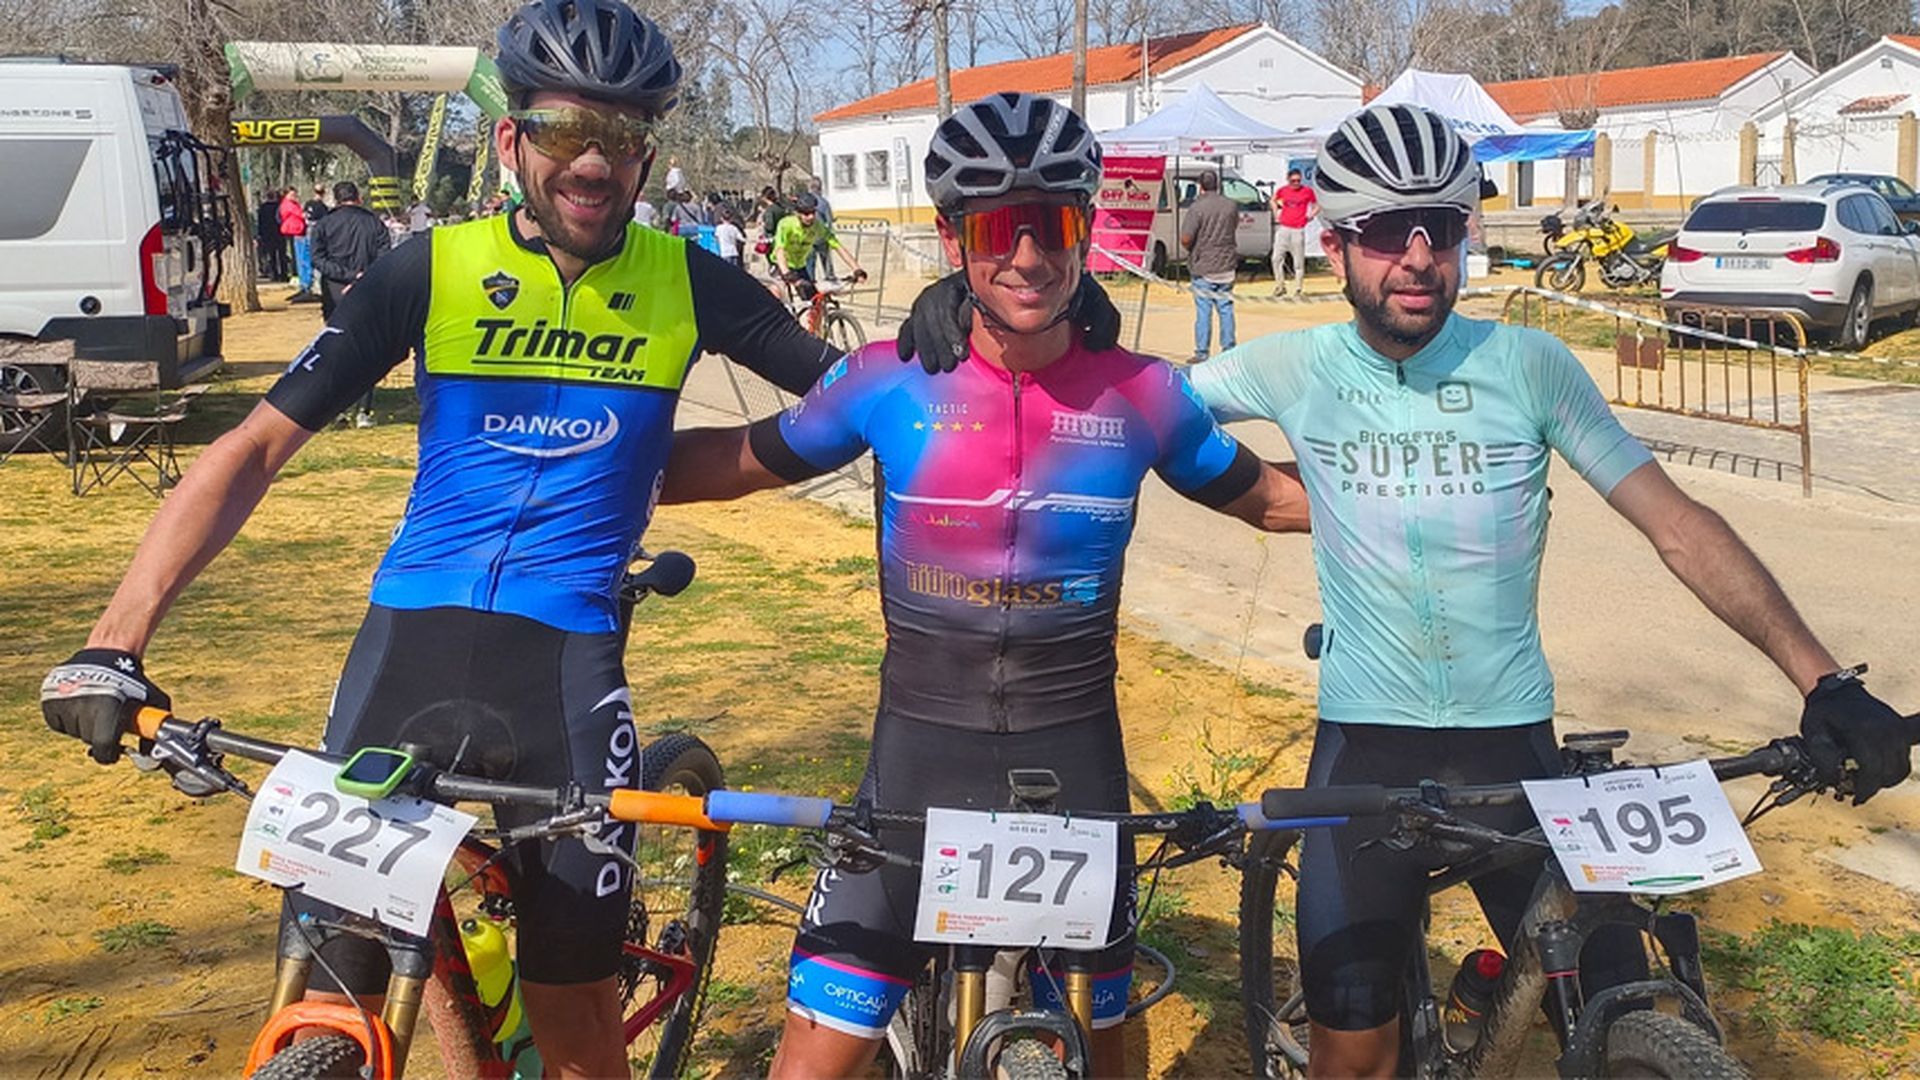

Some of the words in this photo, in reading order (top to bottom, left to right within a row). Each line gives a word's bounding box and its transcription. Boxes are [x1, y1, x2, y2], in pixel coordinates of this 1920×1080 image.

[474, 318, 648, 364] Trimar
[590, 366, 647, 382] TEAM
[1340, 440, 1485, 479] SUPER
[1359, 429, 1457, 445] BICICLETAS
[1341, 480, 1486, 497] PRESTIGIO
[596, 708, 635, 898] DAKOL
[1578, 794, 1707, 855] 195
[286, 791, 432, 877] 227
[967, 843, 1089, 906] 127
